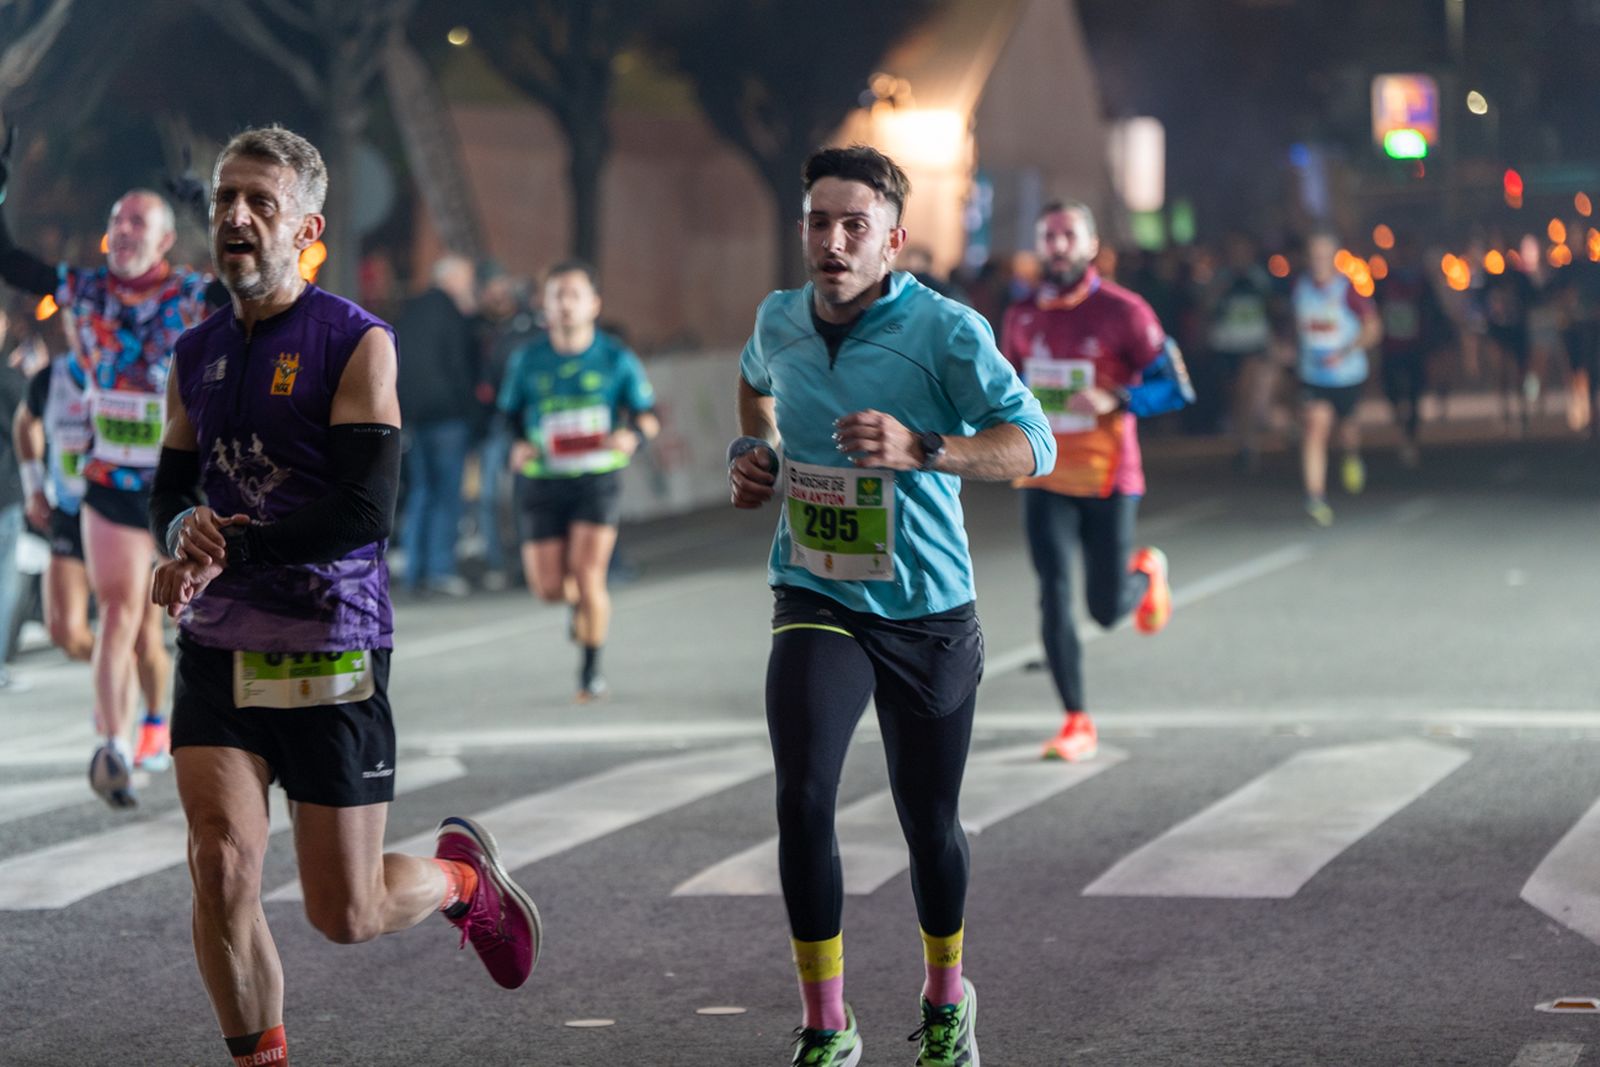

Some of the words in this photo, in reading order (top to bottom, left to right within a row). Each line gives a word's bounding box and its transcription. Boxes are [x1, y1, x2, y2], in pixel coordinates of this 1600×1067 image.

[799, 476, 830, 490] NOCHE
[831, 480, 845, 492] DE
[791, 486, 807, 499] SAN
[803, 504, 859, 543] 295
